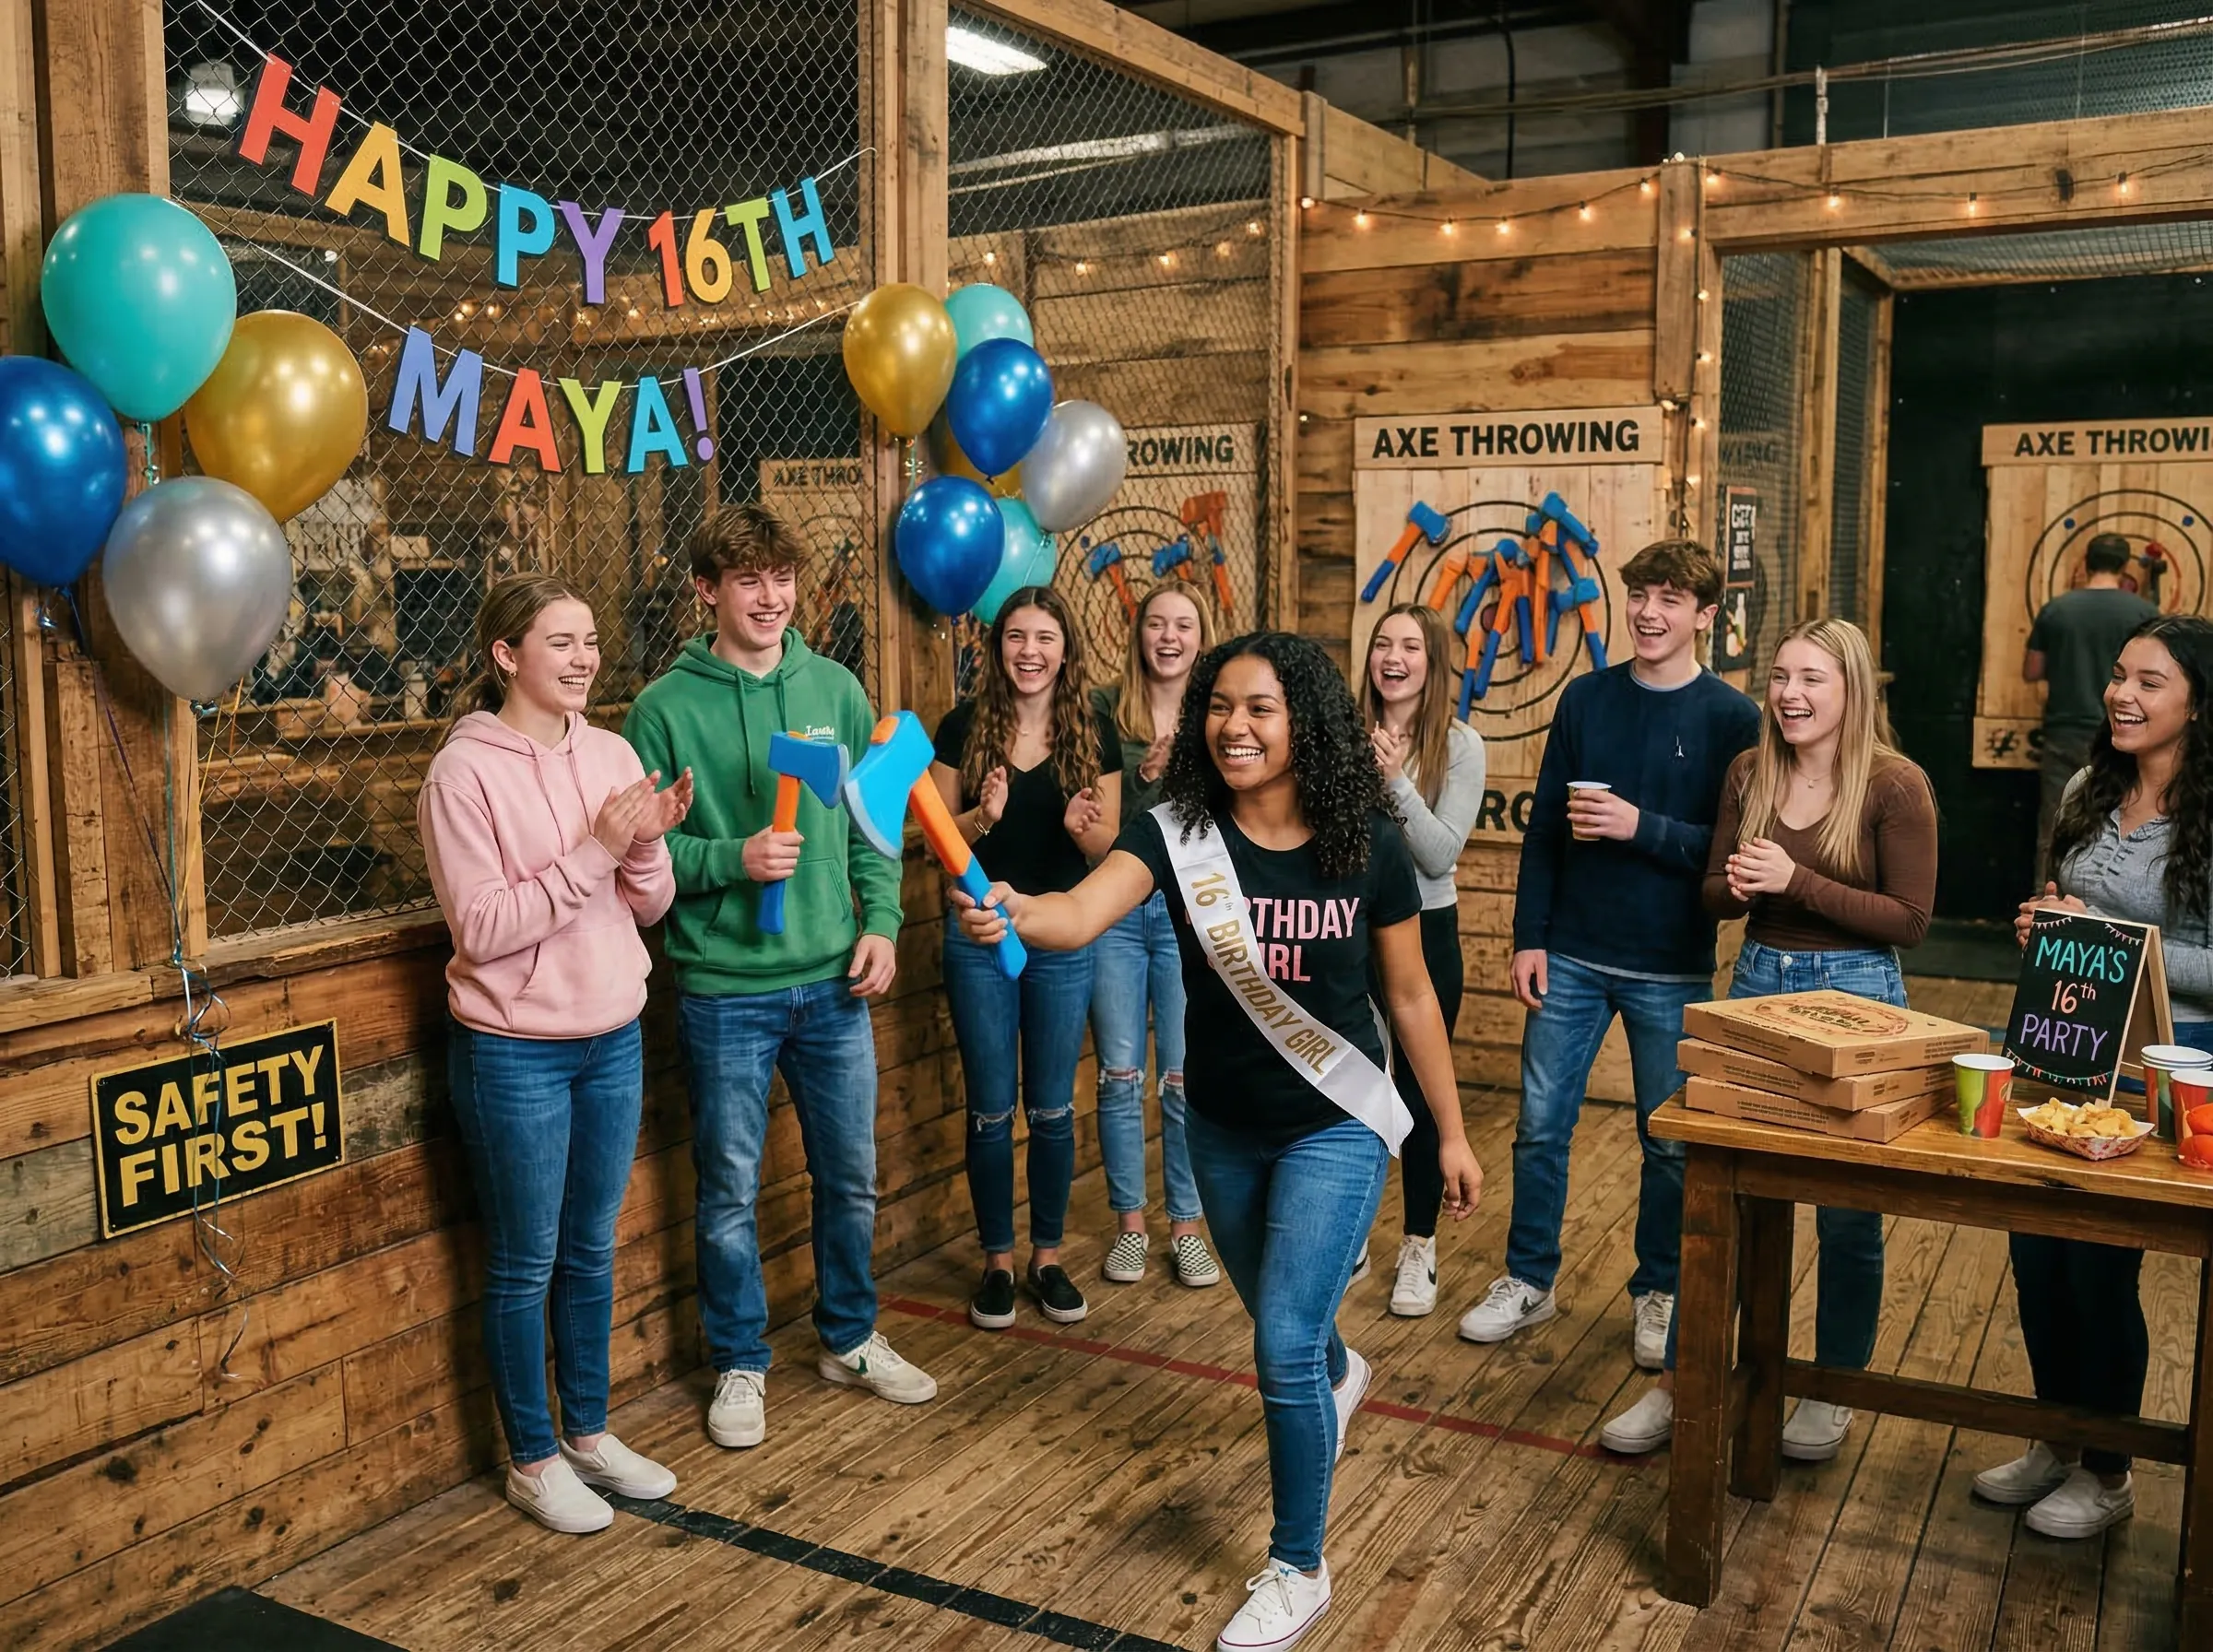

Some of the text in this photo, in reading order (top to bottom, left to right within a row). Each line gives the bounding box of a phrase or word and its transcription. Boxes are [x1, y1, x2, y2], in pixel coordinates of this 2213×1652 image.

[240, 52, 834, 308] HAPPY 16TH
[388, 325, 714, 474] MAYA!
[1372, 419, 1639, 458] AXE THROWING
[2014, 426, 2213, 457] AXE THROWI
[1184, 896, 1360, 940] THDAY
[2034, 936, 2128, 984] MAYA'S
[1207, 919, 1303, 1031] BIRTHDAY
[1284, 1029, 1337, 1076] GIRL
[2051, 979, 2097, 1014] 16th
[2019, 1013, 2109, 1062] PARTY
[114, 1044, 324, 1146] SAFETY
[120, 1101, 327, 1209] FIRST!
